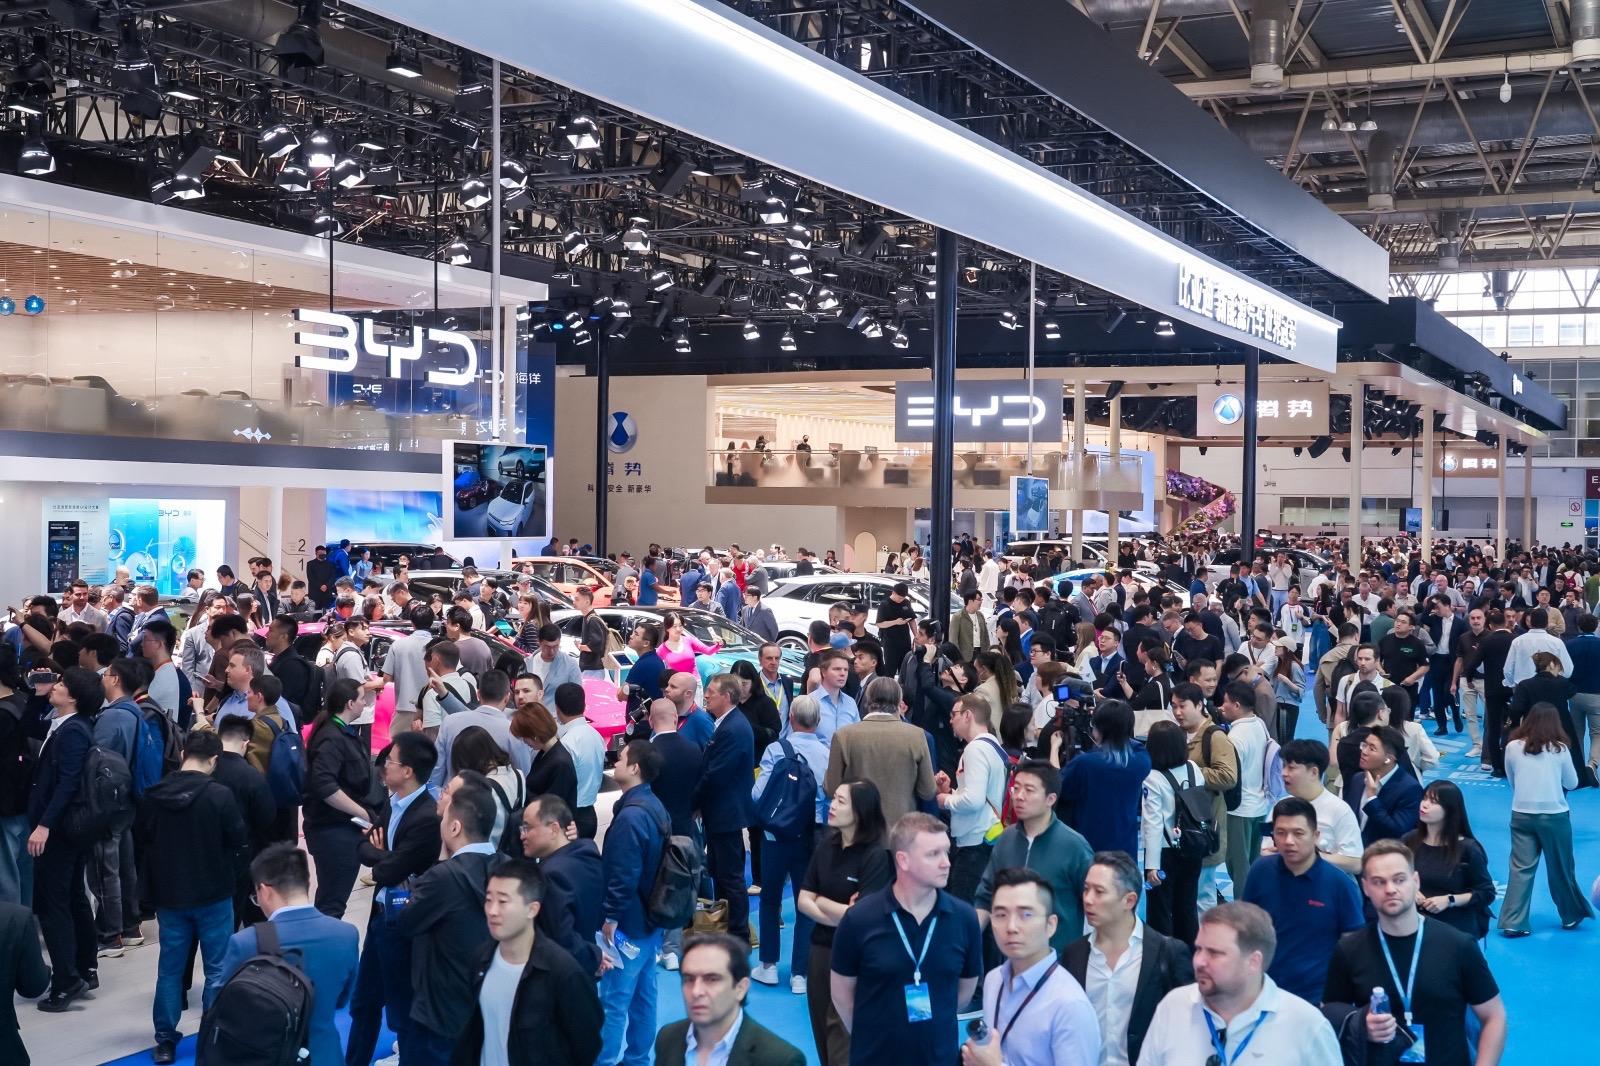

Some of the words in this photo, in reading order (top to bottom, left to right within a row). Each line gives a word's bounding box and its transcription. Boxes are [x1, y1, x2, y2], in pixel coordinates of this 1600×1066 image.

[294, 308, 478, 386] BYD
[298, 538, 306, 552] 2
[298, 557, 304, 571] 1
